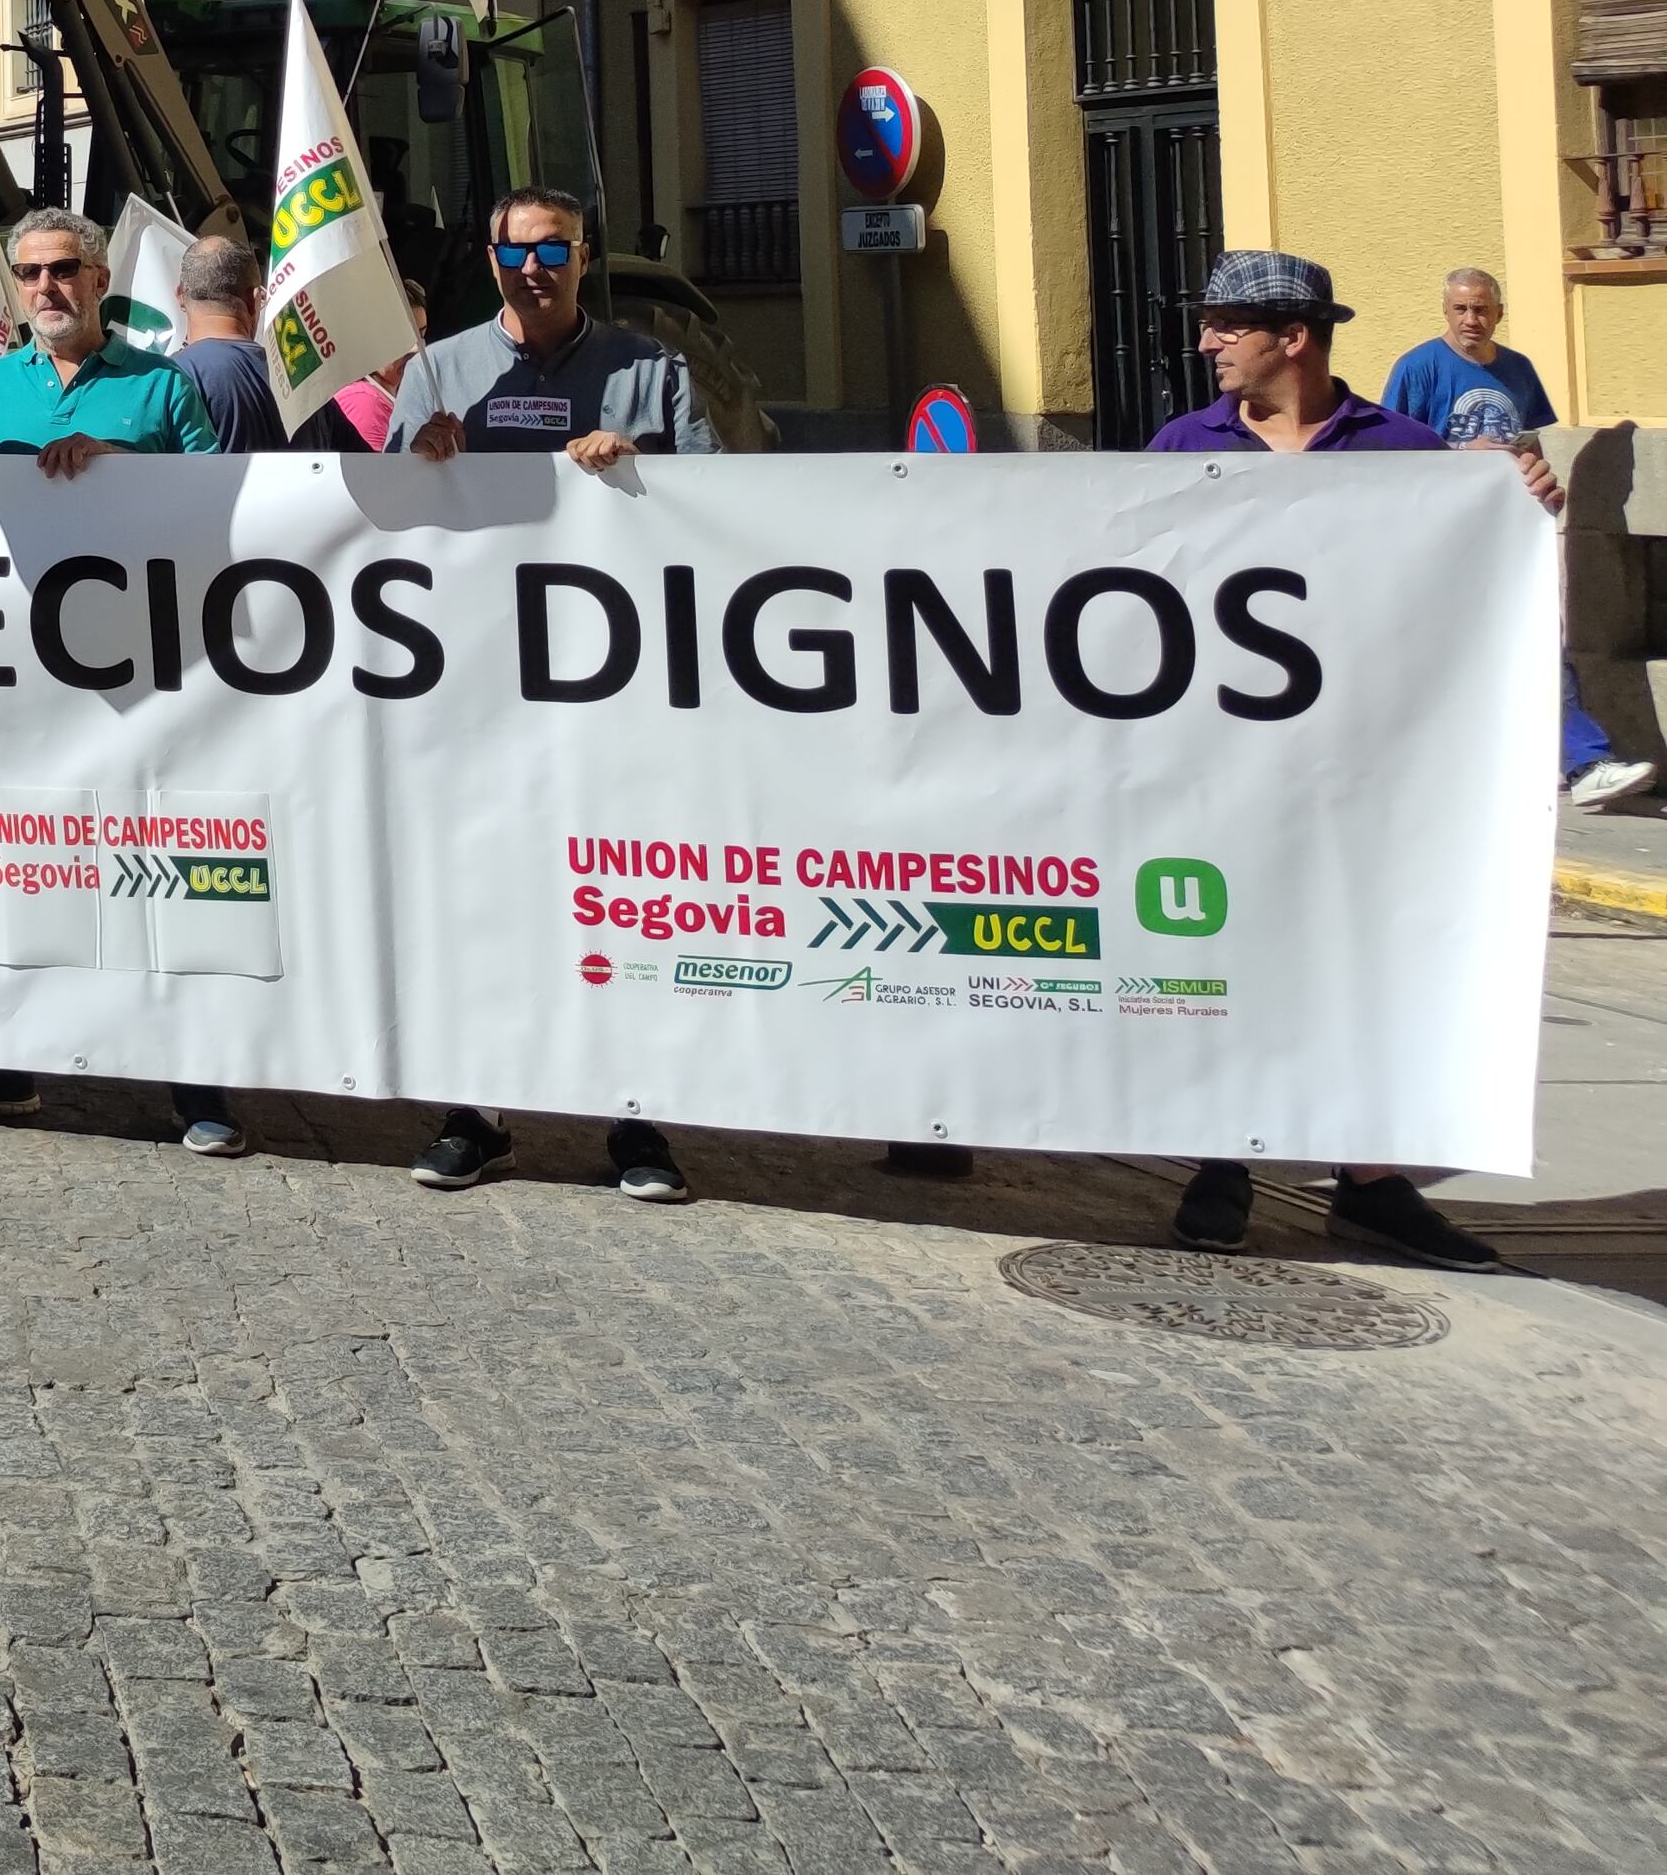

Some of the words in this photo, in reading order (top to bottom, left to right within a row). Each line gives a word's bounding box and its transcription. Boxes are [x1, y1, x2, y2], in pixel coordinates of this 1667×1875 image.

[273, 170, 362, 249] UCCL
[865, 212, 891, 228] EXCEPTO
[857, 231, 901, 249] JUZGADOS
[489, 400, 510, 410] UNION
[512, 400, 521, 410] DE
[523, 400, 568, 412] CAMPESINOS
[489, 413, 520, 423] Segovia
[516, 562, 1324, 722] DIGNOS
[63, 815, 97, 846] DE
[102, 815, 268, 851] CAMPESINOS
[568, 836, 708, 882] UNION
[724, 845, 782, 886] DE
[796, 848, 1100, 898] CAMPESINOS
[189, 865, 268, 895] UCCL
[1159, 875, 1206, 922] u
[572, 885, 786, 941] Segovia
[973, 913, 1087, 953] UCCL
[676, 960, 783, 983] mesenor
[673, 986, 733, 998] cooperativa
[875, 984, 911, 995] GRUPO
[915, 985, 956, 996] ASESOR
[968, 976, 1001, 991] UNI
[1055, 982, 1100, 992] SEGUROS
[1162, 980, 1227, 995] ISMUR
[968, 993, 1063, 1013] SEGOVIA,
[1068, 998, 1103, 1013] S.L.
[1118, 1005, 1174, 1017] Mujeres
[1177, 1006, 1228, 1017] Rurales
